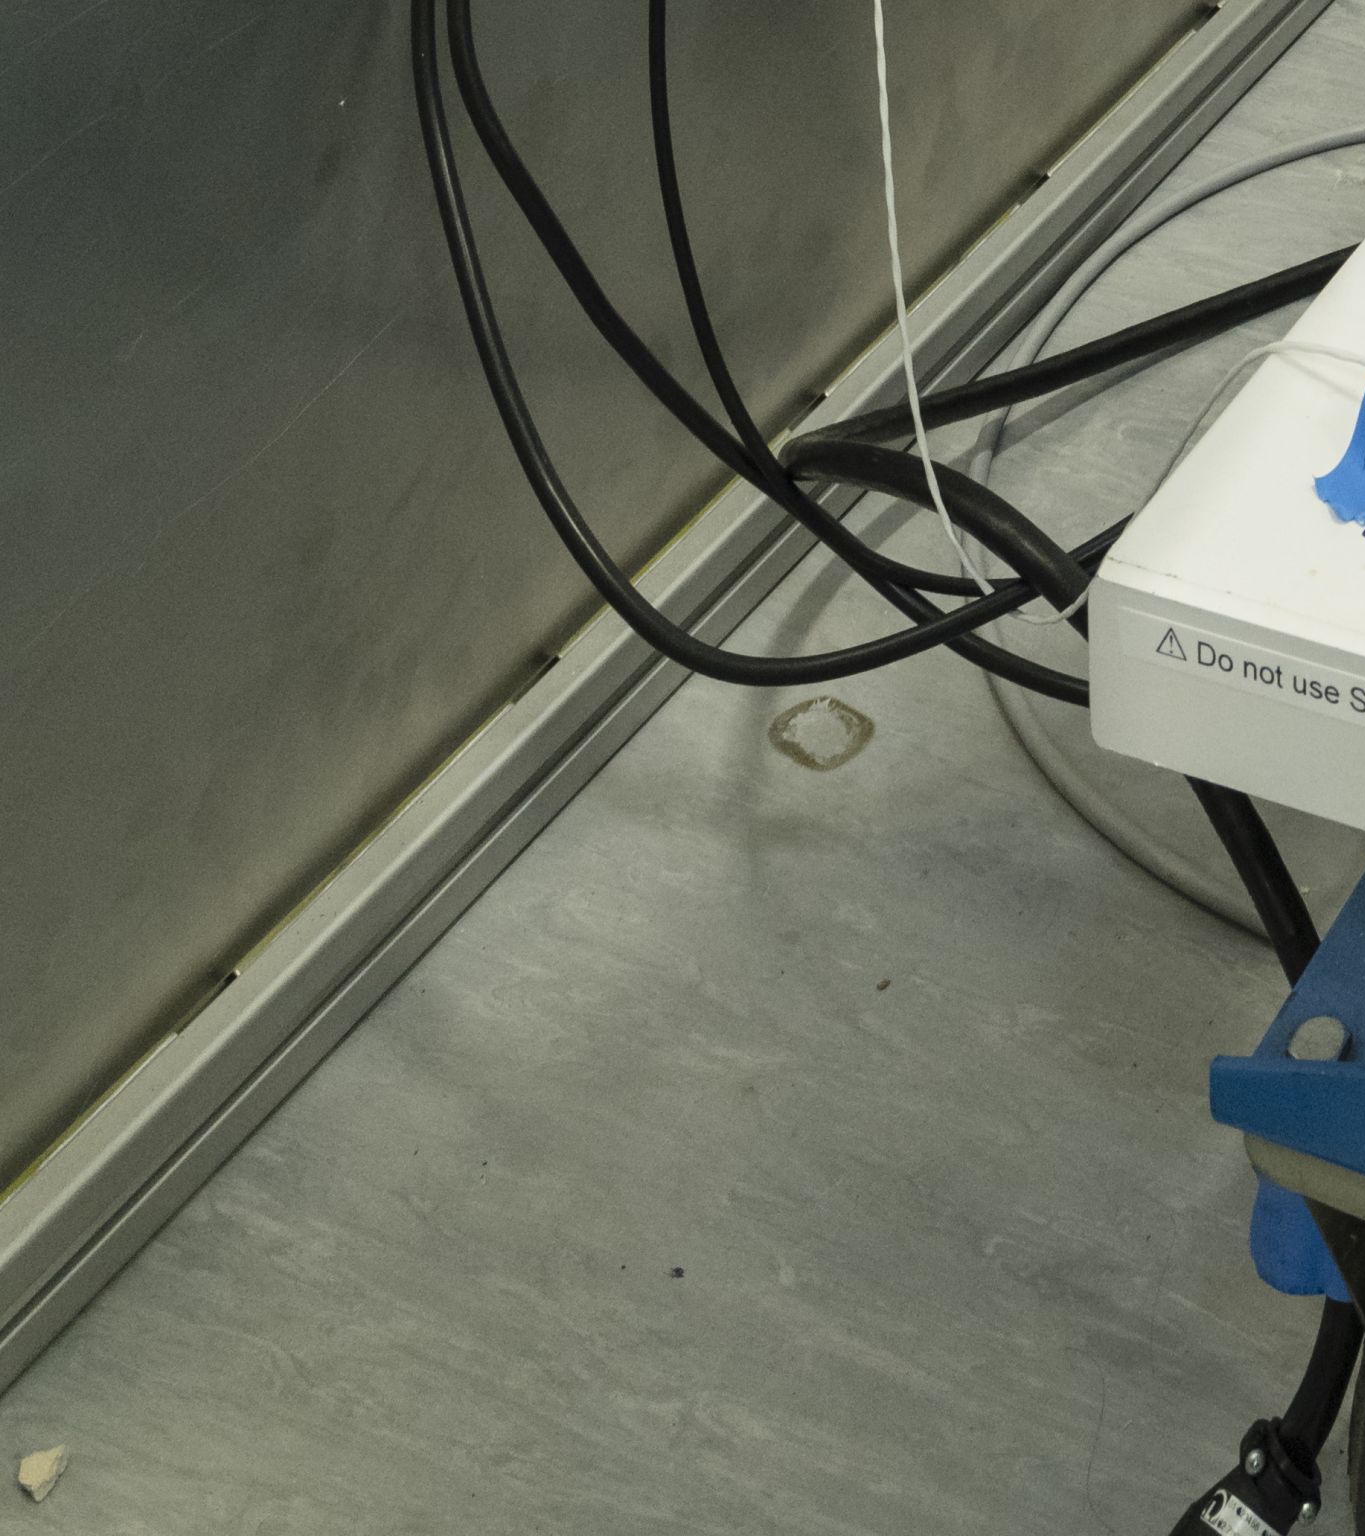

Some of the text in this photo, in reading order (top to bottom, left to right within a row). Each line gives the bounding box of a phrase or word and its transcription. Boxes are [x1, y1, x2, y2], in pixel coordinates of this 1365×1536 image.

[1196, 640, 1234, 673] Do
[1243, 662, 1284, 690] not
[1291, 672, 1341, 706] use
